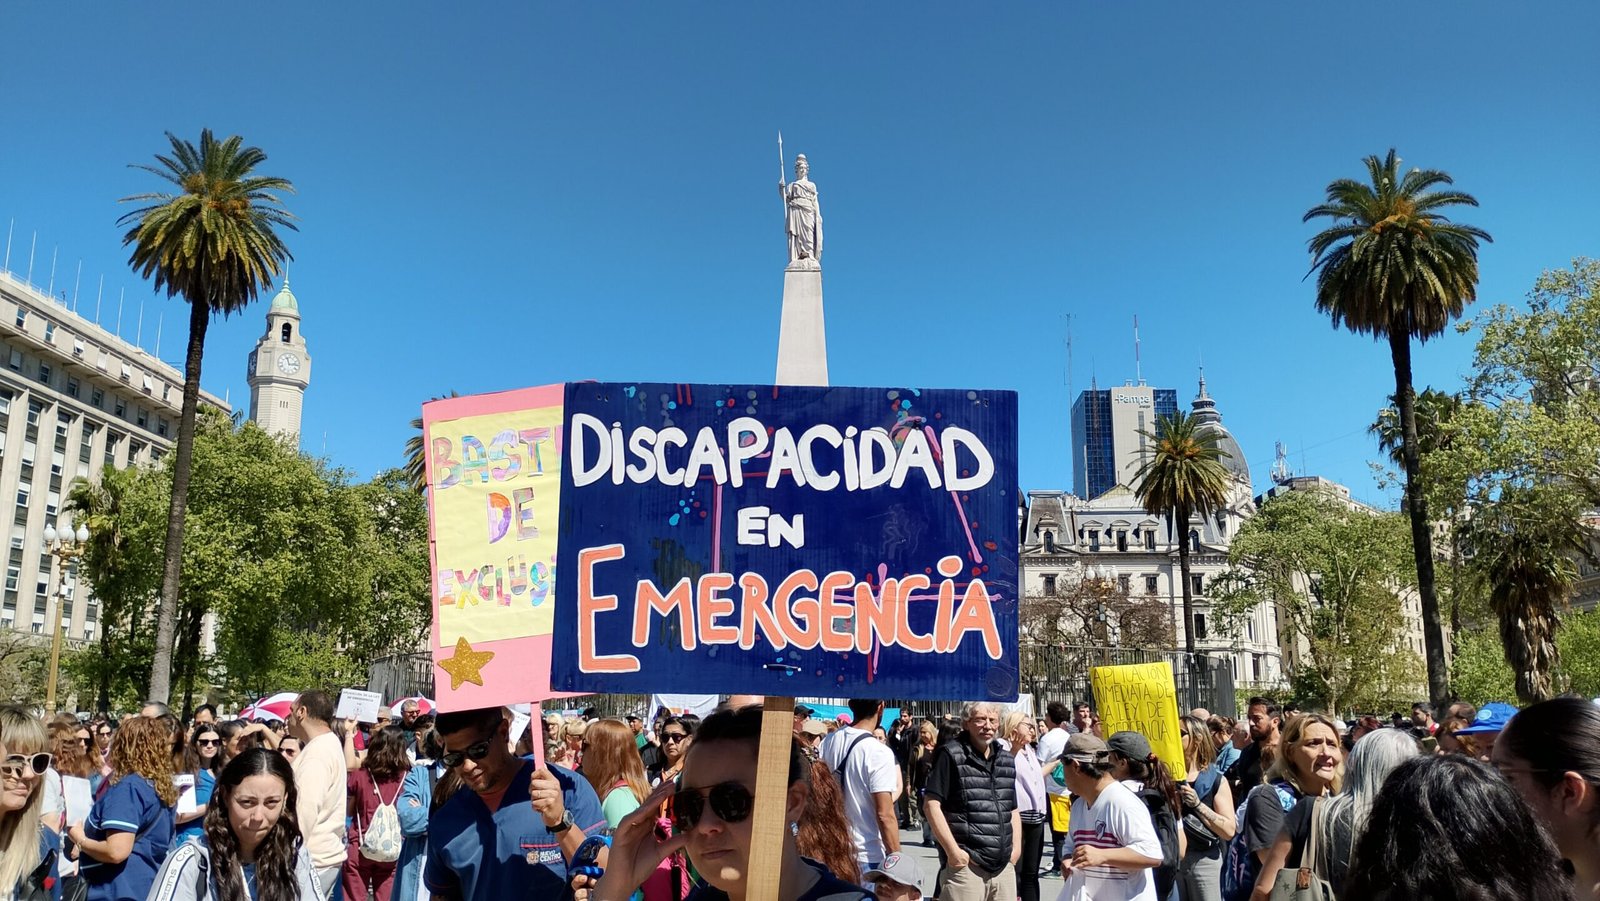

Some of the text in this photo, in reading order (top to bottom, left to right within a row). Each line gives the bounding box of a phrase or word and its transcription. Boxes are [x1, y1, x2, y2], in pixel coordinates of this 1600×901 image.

[1119, 394, 1151, 406] Pampa
[486, 487, 540, 544] DE
[737, 506, 804, 549] EN
[1093, 665, 1168, 685] APLICACIÓN
[1094, 681, 1172, 703] INMEDIATA DE
[1117, 703, 1138, 721] LEY
[1147, 701, 1165, 718] DE
[176, 847, 192, 862] Cal
[540, 853, 561, 862] CENTRO
